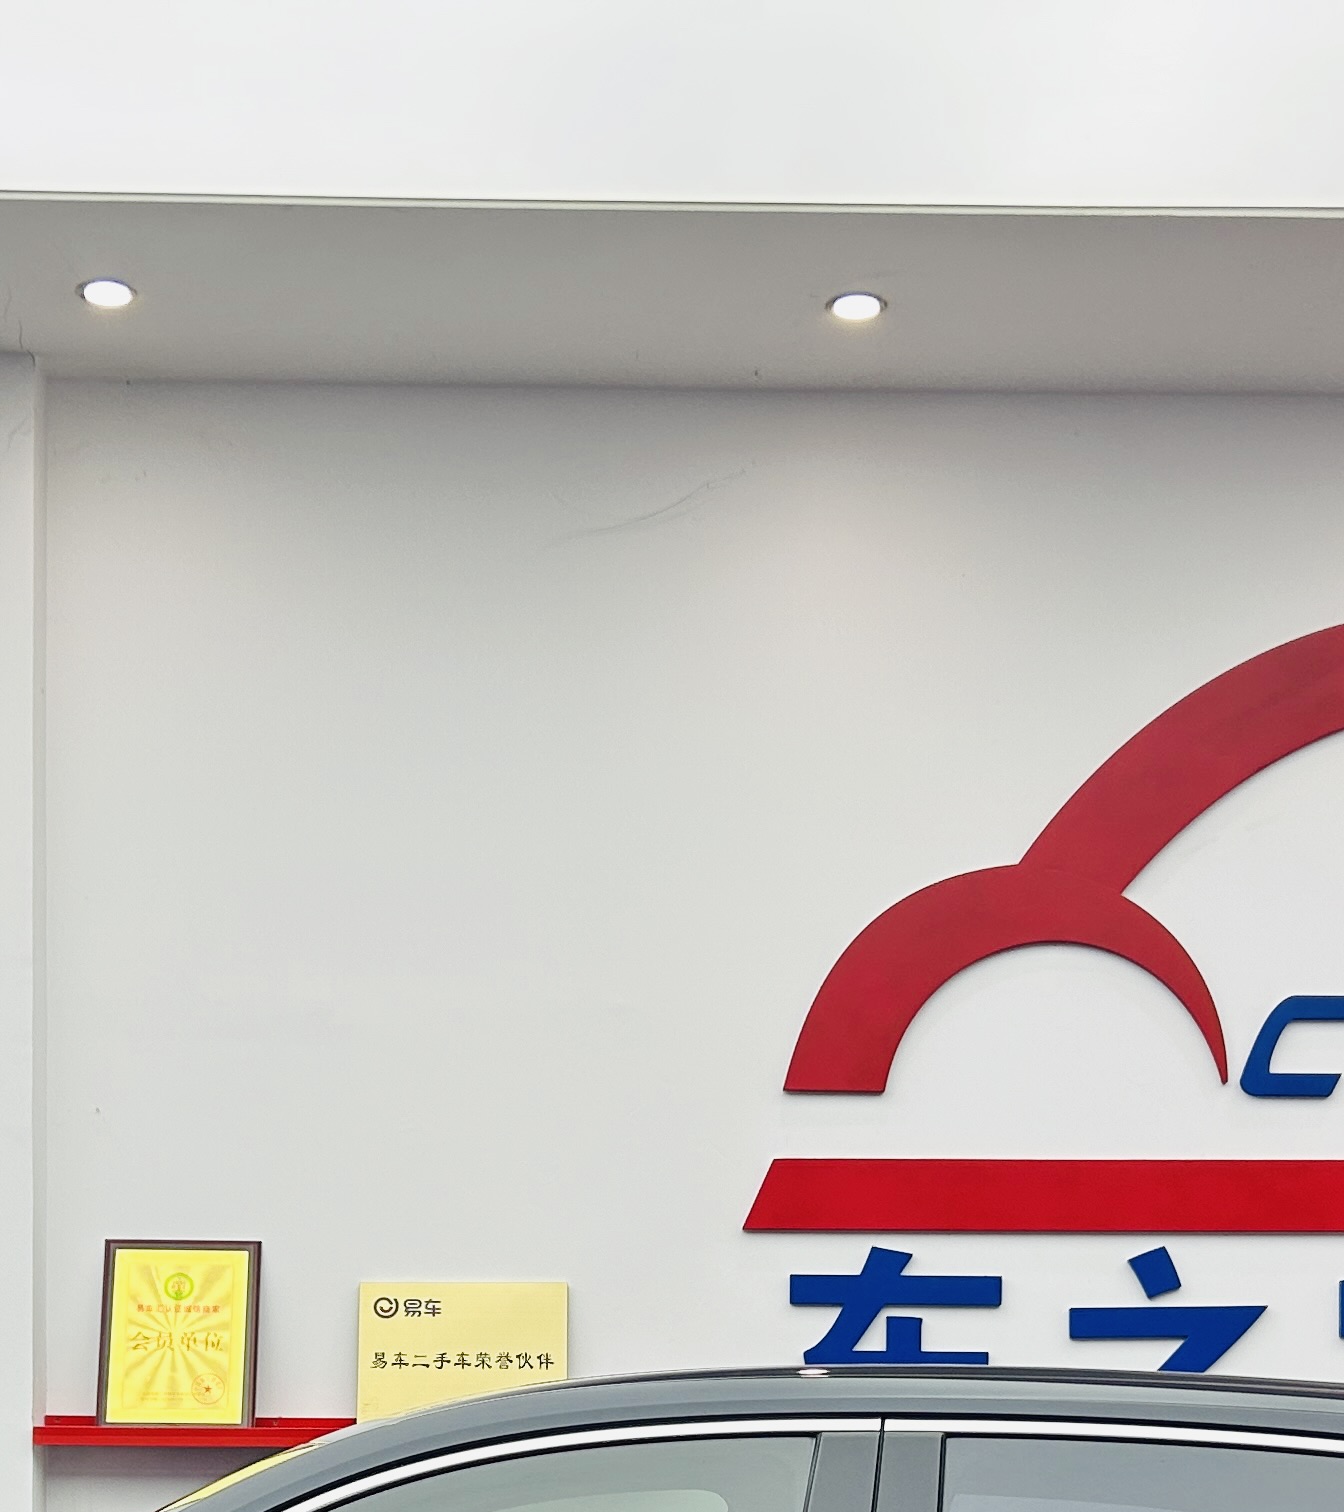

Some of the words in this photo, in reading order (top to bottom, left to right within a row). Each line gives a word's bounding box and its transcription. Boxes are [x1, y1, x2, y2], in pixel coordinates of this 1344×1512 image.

[403, 1298, 443, 1318] 易车
[129, 1331, 224, 1352] 会员单位
[369, 1351, 555, 1371] 易车二手车荣誉伙伴
